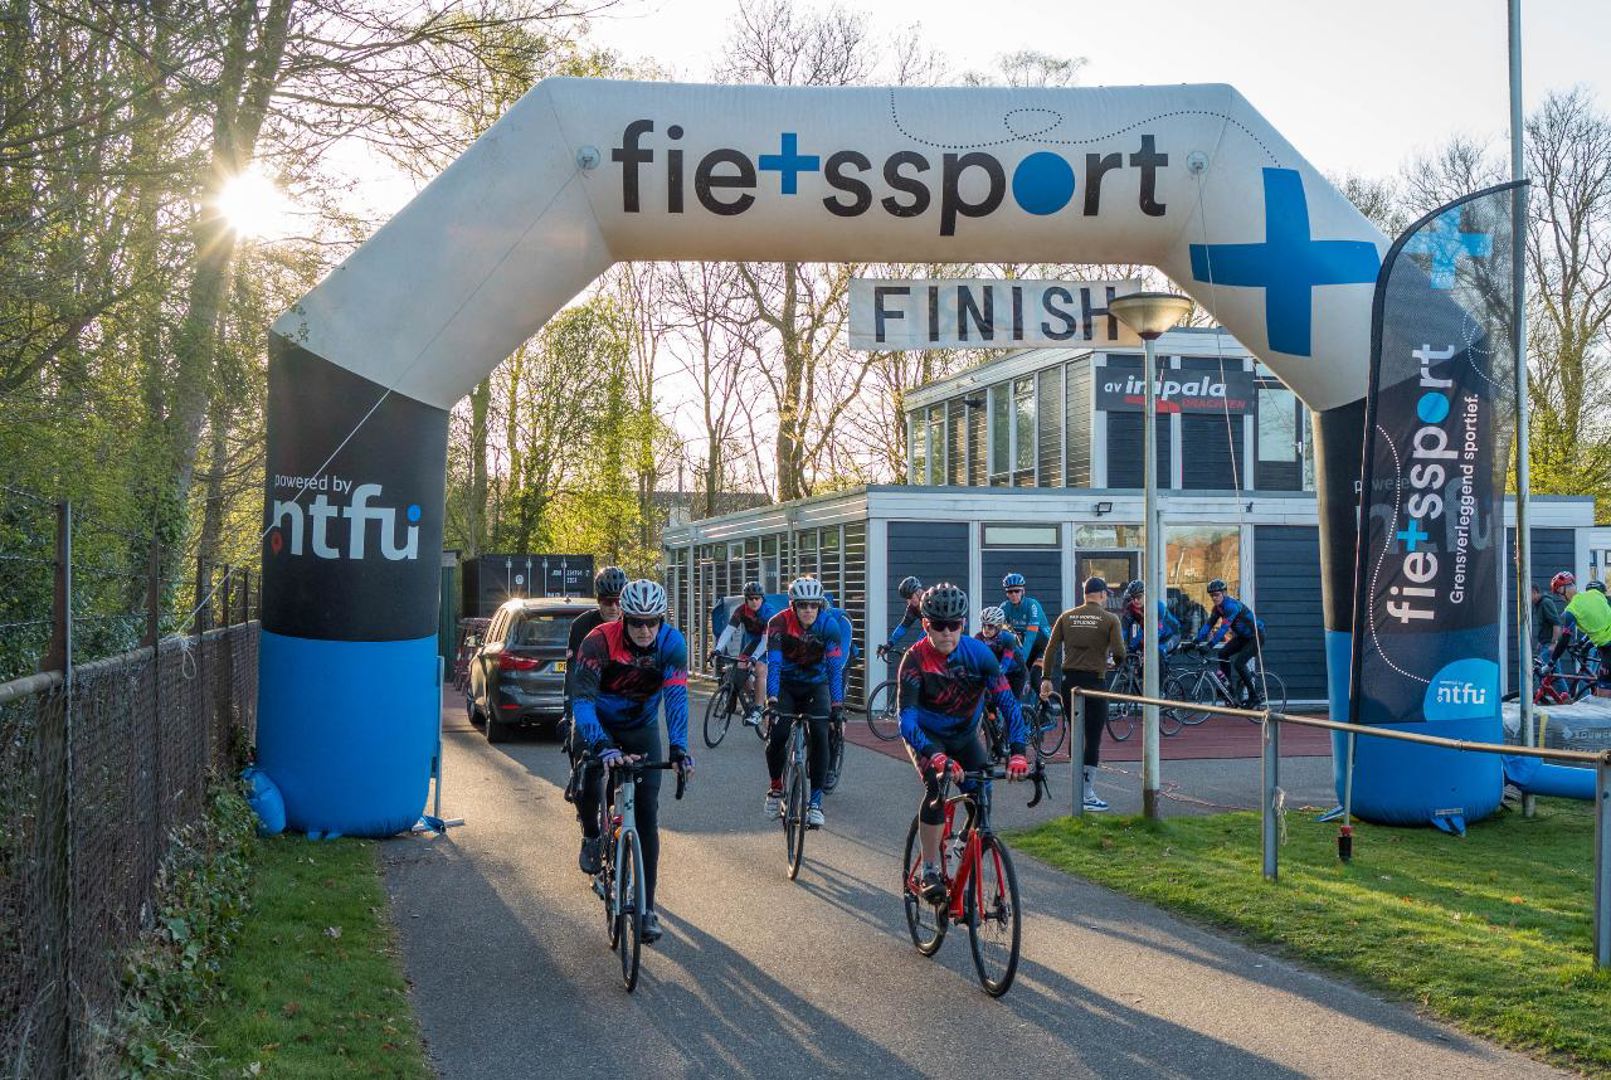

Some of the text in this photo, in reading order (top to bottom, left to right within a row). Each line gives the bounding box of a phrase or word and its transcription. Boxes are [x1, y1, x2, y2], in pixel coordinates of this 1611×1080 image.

[873, 285, 1118, 343] FINISH
[275, 474, 352, 494] powered by
[1450, 393, 1479, 604] Grensverleggend sportief.
[271, 483, 422, 561] ntfu
[1436, 682, 1486, 705] ntfu
